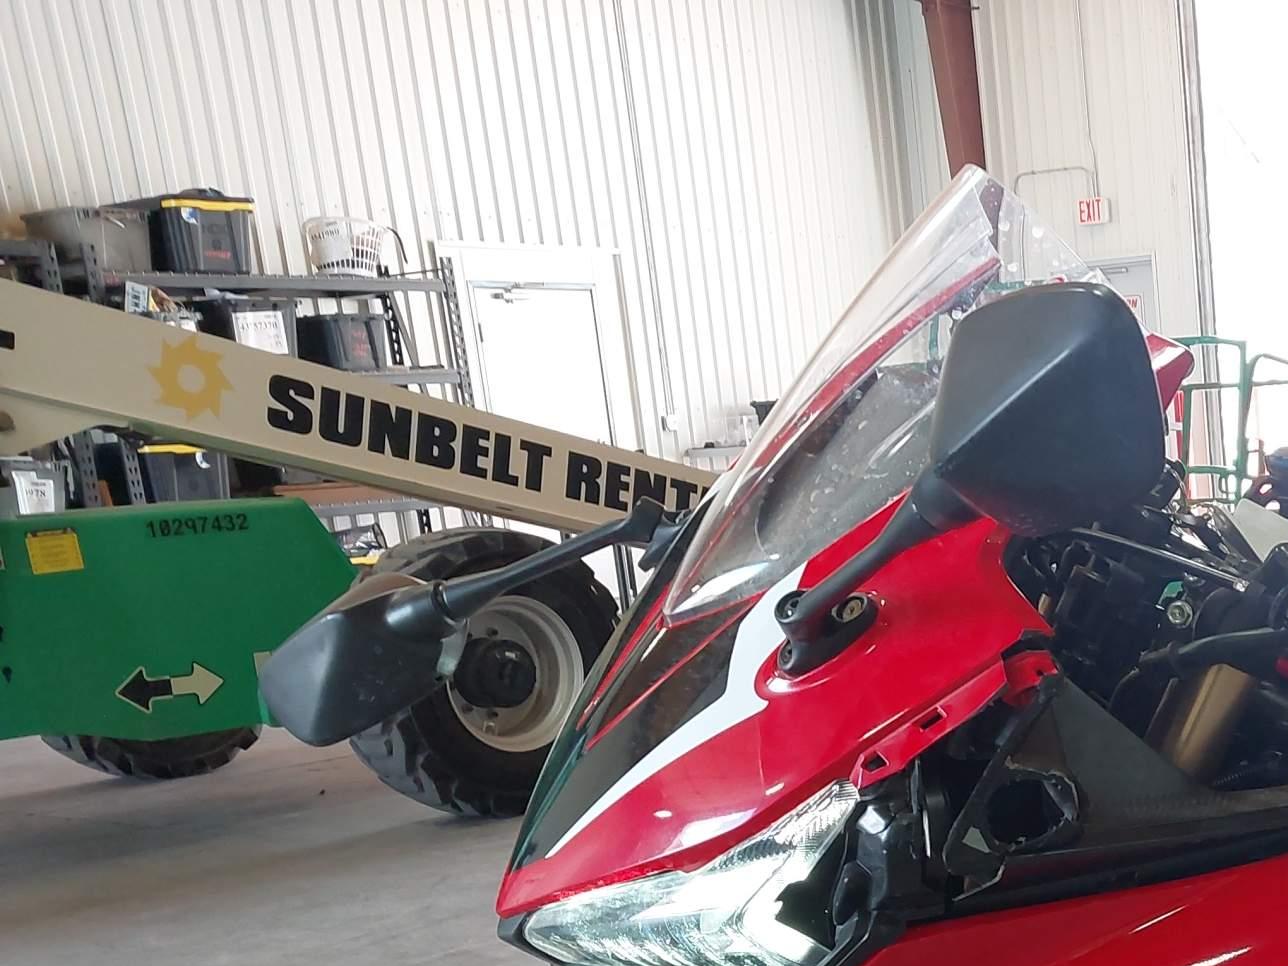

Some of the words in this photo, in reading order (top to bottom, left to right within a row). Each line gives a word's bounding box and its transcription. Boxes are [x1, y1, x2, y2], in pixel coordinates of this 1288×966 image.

[1078, 199, 1102, 223] EXIT
[266, 373, 553, 493] SUNBELT
[565, 450, 710, 512] RENT
[146, 512, 249, 538] 10297432
